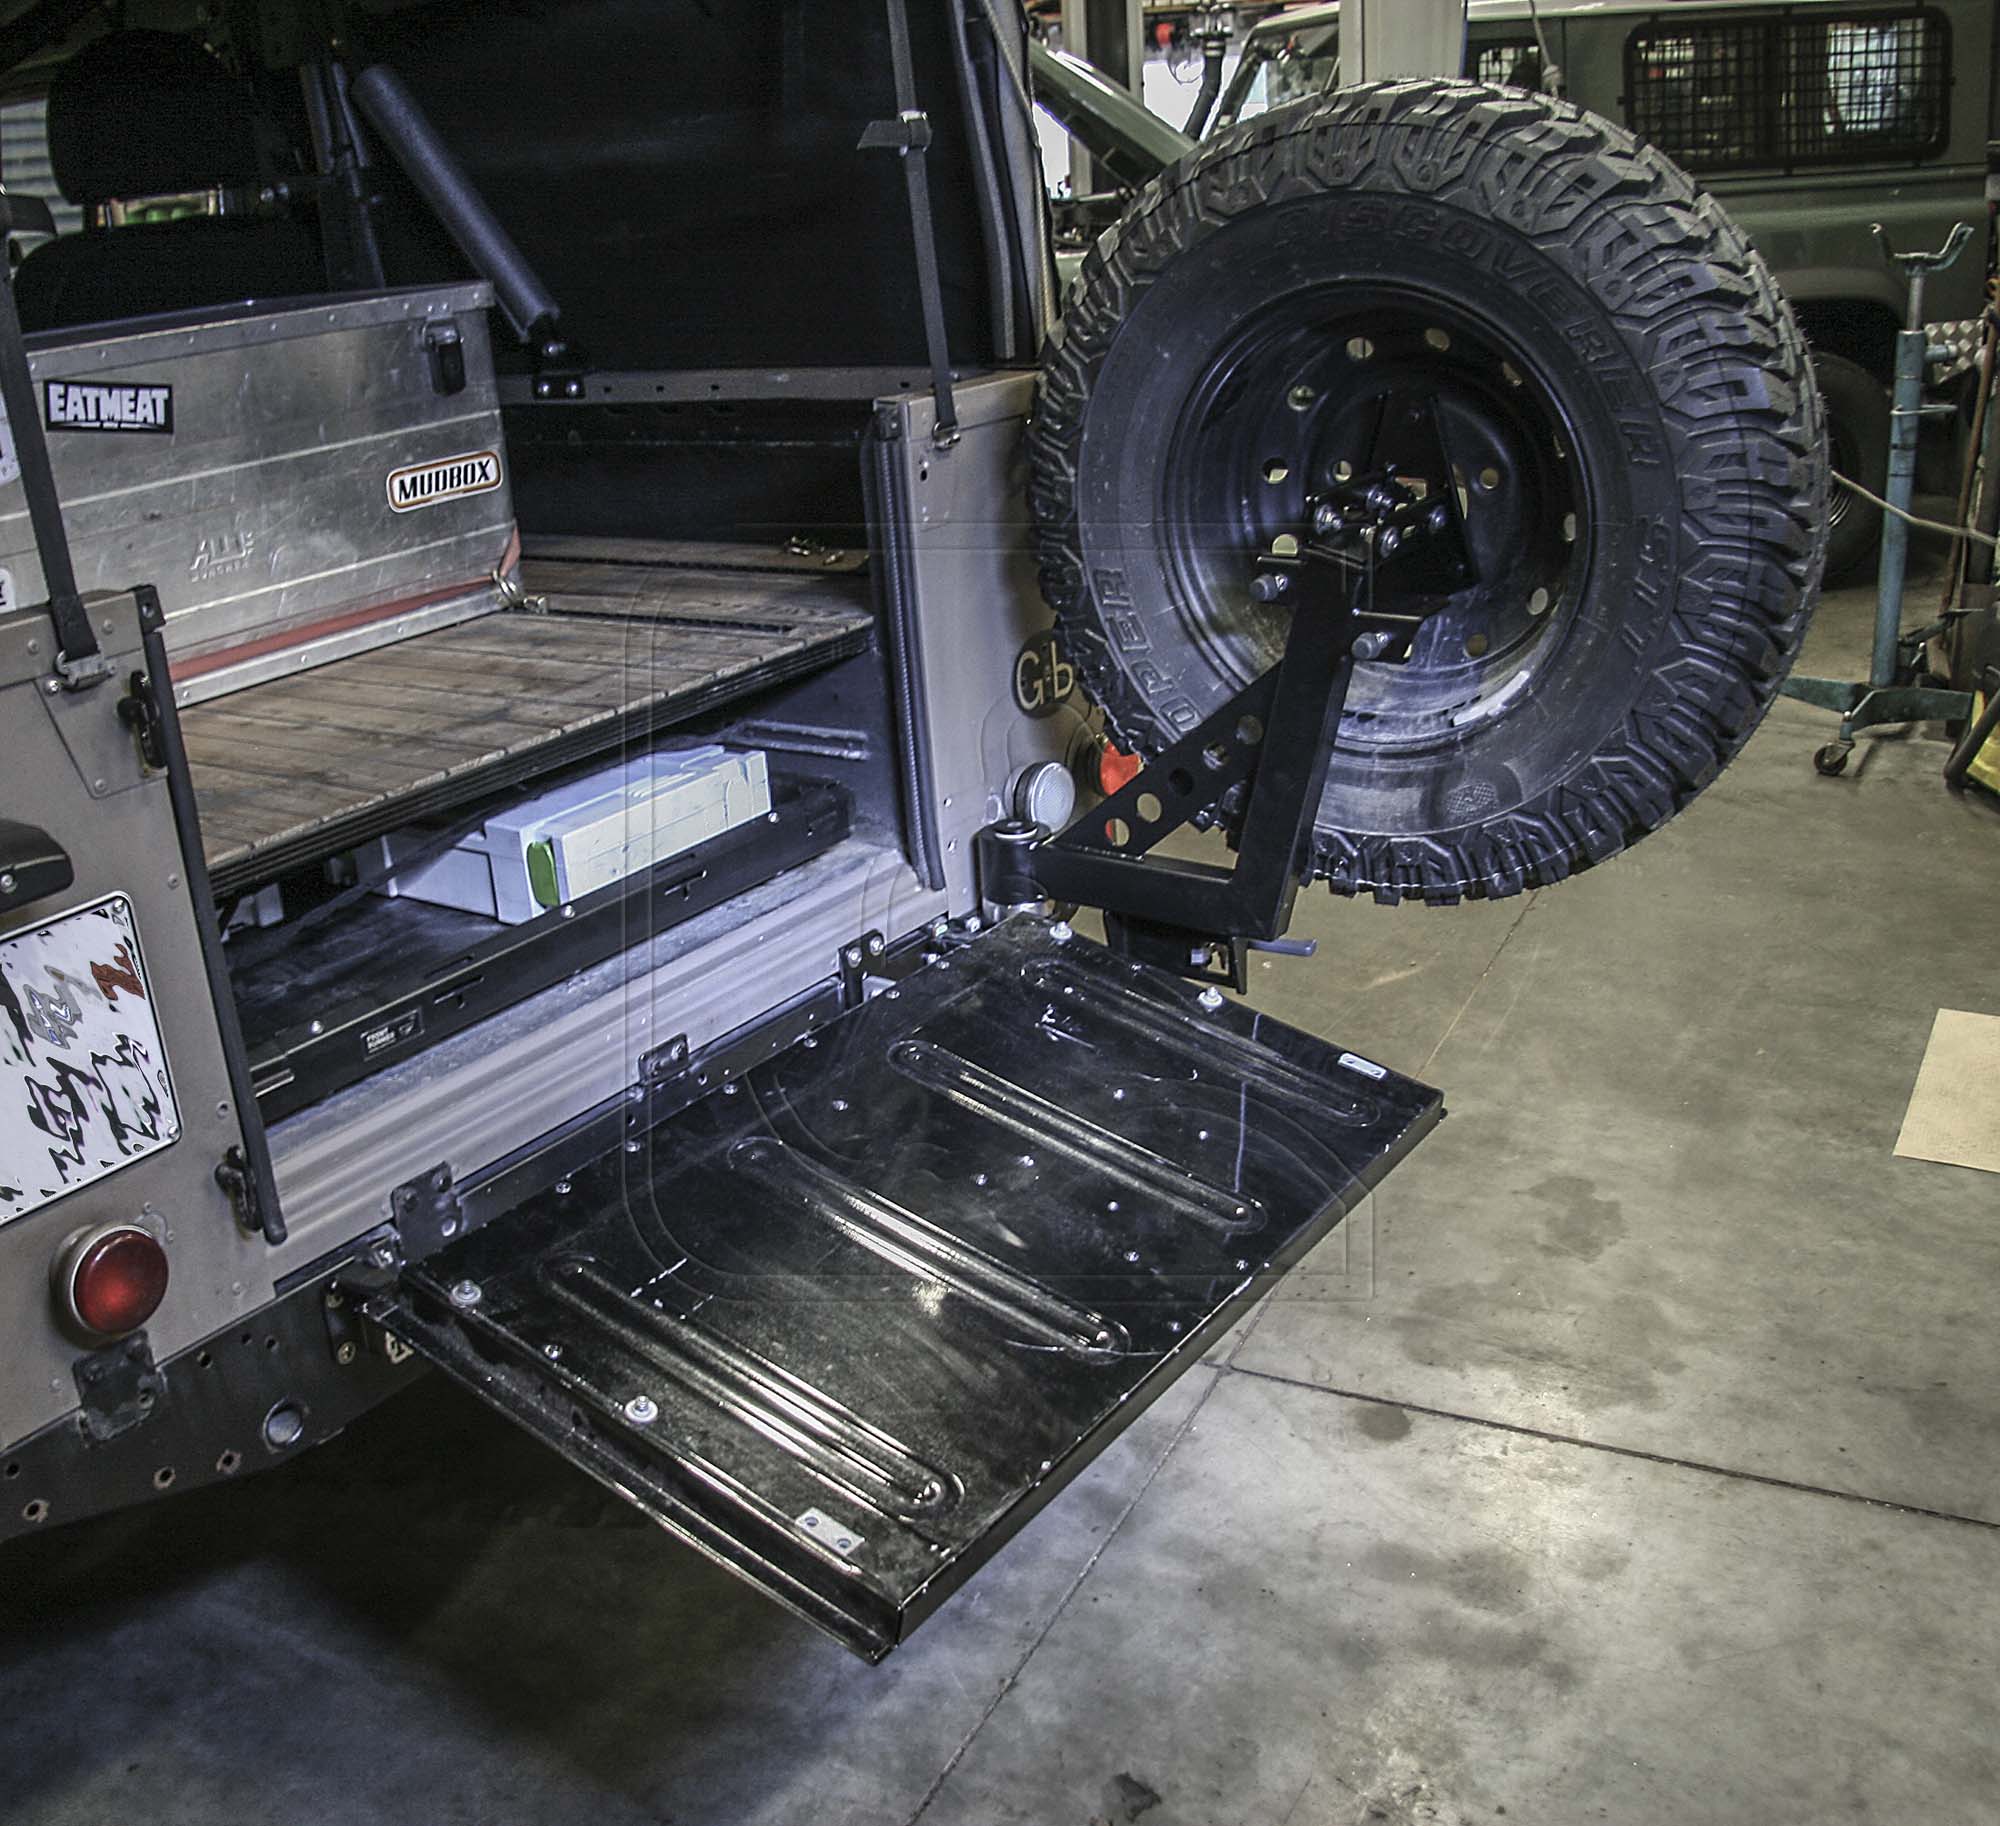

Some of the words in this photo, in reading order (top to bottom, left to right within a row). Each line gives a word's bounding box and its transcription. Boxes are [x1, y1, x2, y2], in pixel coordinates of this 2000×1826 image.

[48, 383, 169, 425] EATMEAT
[398, 459, 491, 503] MUDBOX
[1016, 640, 1074, 710] Gb
